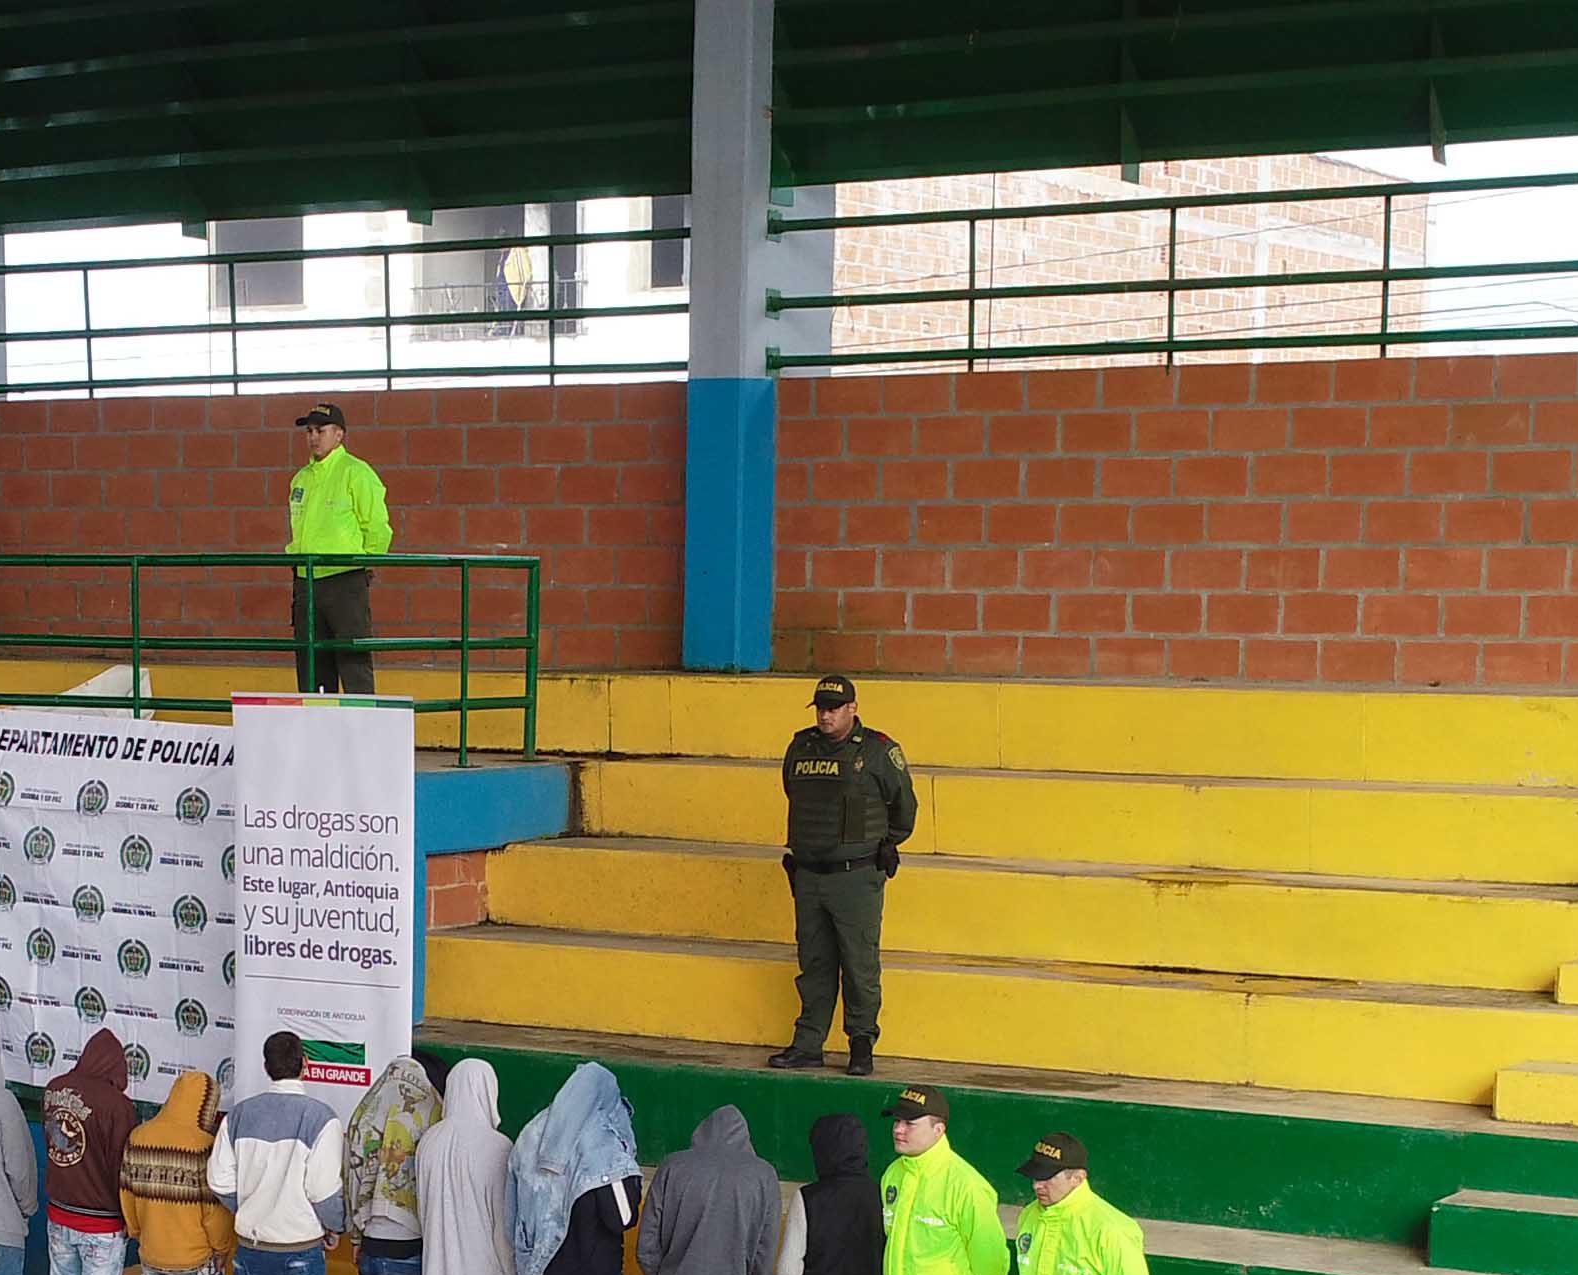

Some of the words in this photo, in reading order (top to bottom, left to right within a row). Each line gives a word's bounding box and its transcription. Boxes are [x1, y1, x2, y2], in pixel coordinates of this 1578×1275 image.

[121, 737, 147, 760] DE
[148, 737, 219, 766] POLICÍA
[795, 760, 839, 776] POLICIA
[244, 804, 277, 829] Las
[282, 804, 355, 838] drogas
[359, 813, 399, 834] son
[243, 845, 283, 866] una
[290, 842, 399, 872] maldición.
[243, 876, 275, 892] Este
[278, 876, 320, 899] lugar,
[323, 880, 399, 904] Antioquia
[243, 904, 257, 932] y
[261, 904, 289, 926] su
[291, 902, 400, 938] juventud,
[244, 934, 295, 958] libres
[300, 938, 323, 960] de
[327, 940, 397, 970] drogas.
[311, 1068, 325, 1079] EN
[325, 1070, 365, 1082] GRANDE
